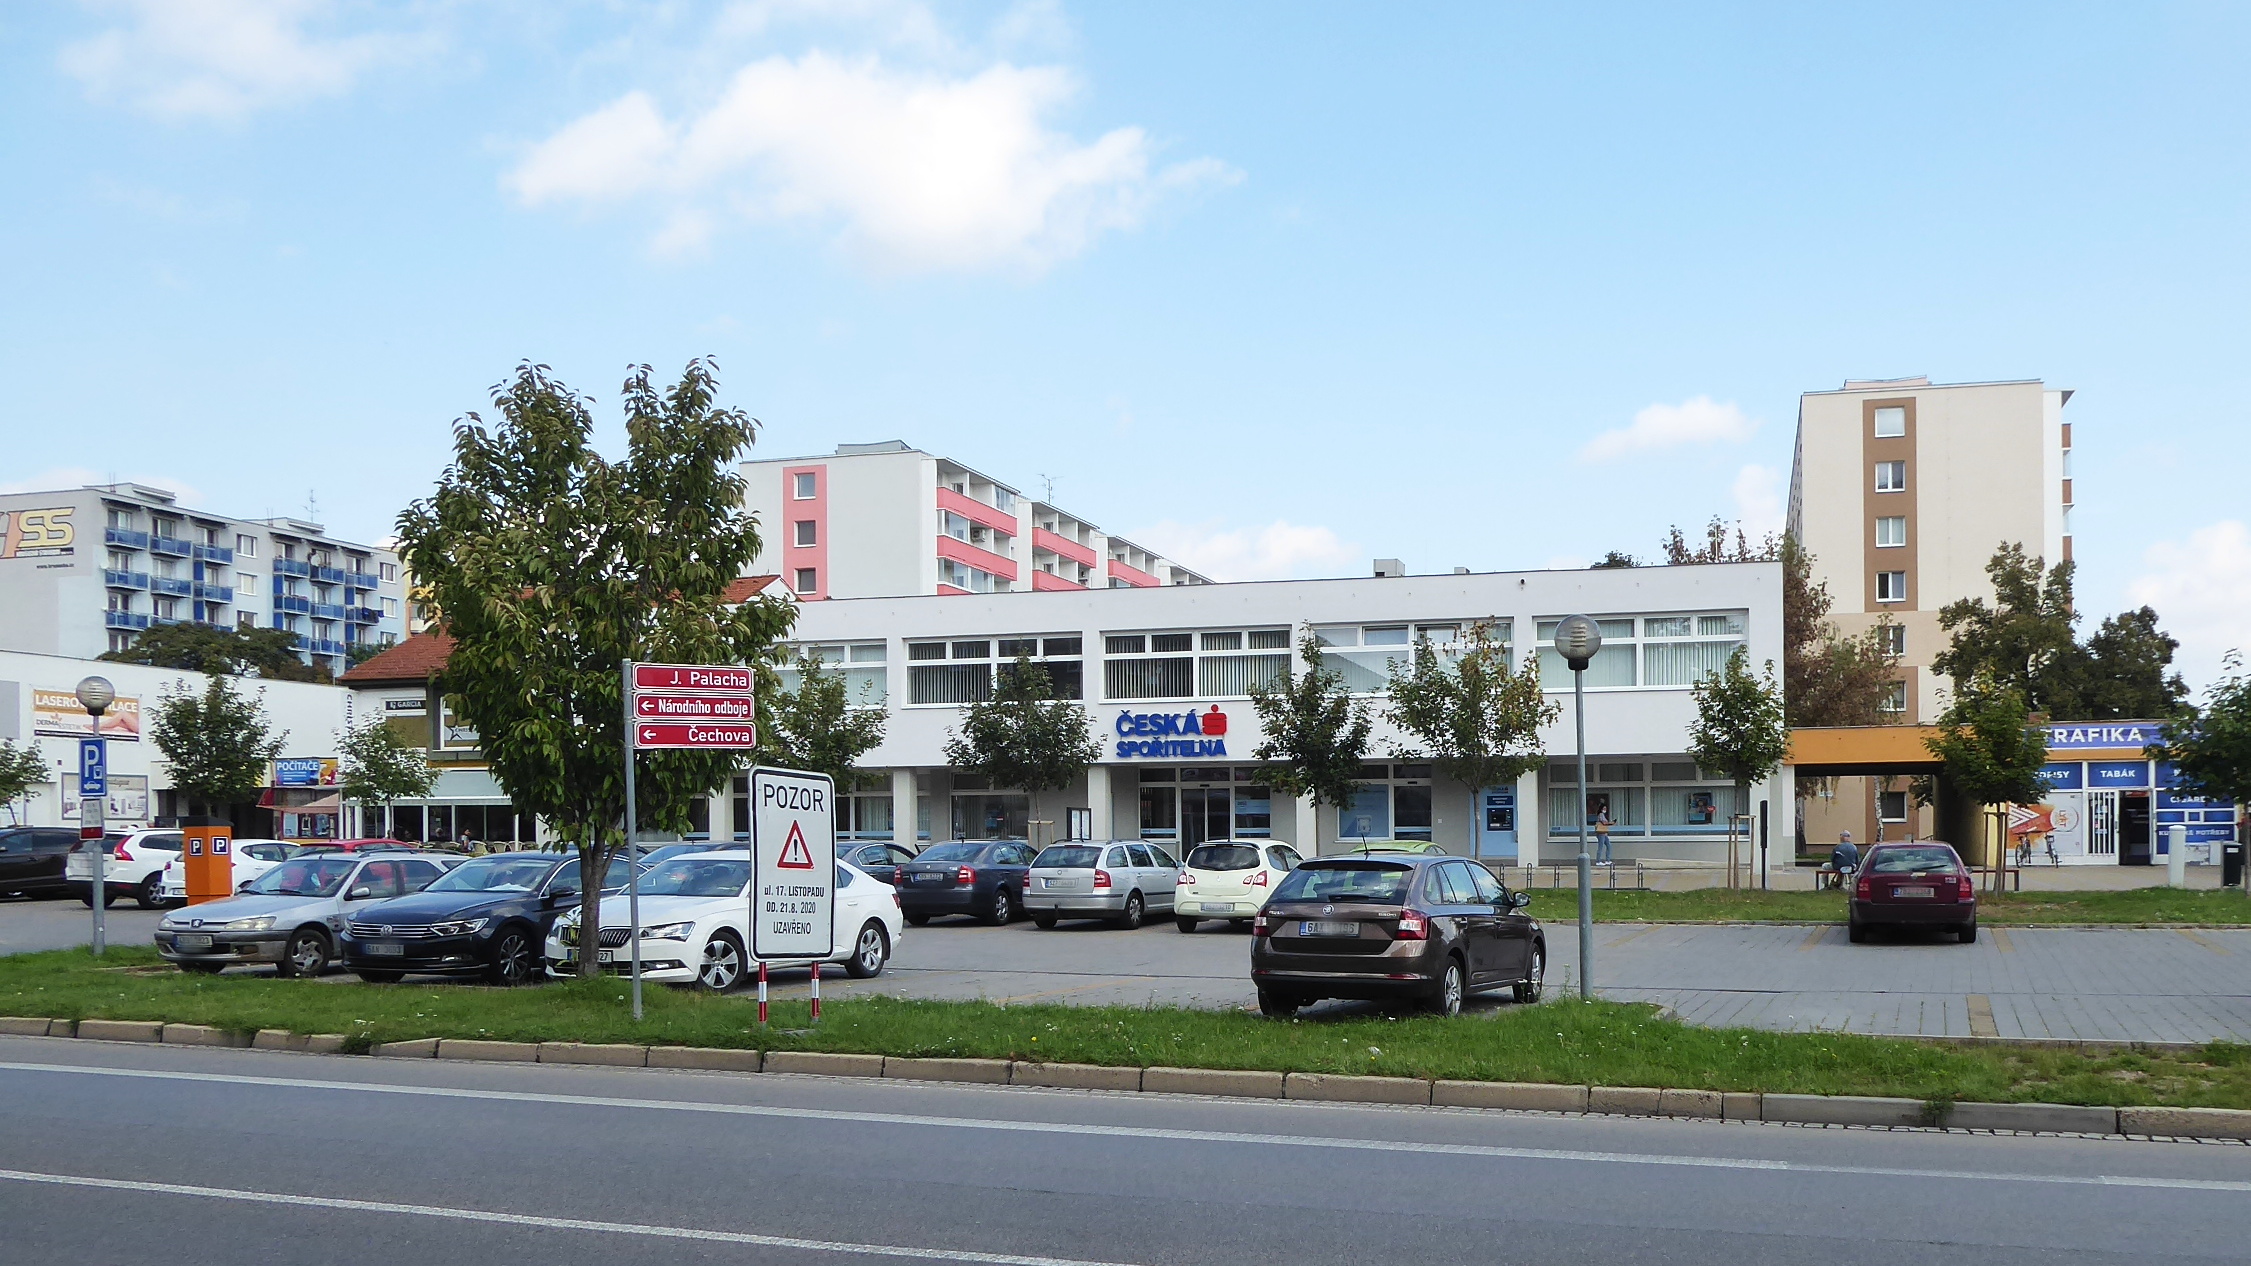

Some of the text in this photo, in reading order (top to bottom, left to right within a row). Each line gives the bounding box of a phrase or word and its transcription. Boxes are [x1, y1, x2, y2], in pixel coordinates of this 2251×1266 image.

[669, 670, 747, 687] J. Palacha
[658, 698, 748, 718] Národního odboje
[1116, 709, 1202, 737] ČESKÁ
[688, 724, 750, 742] Čechova
[1116, 737, 1227, 757] SPOŘITELNA
[277, 760, 319, 771] POČÍTAČE
[2100, 769, 2136, 778] TABÁK
[763, 783, 824, 812] POZOR
[764, 885, 825, 898] ul. 17. LISTOPADU
[766, 901, 816, 914] OD. 21.8. 2020
[773, 919, 812, 935] UZAVŘENO
